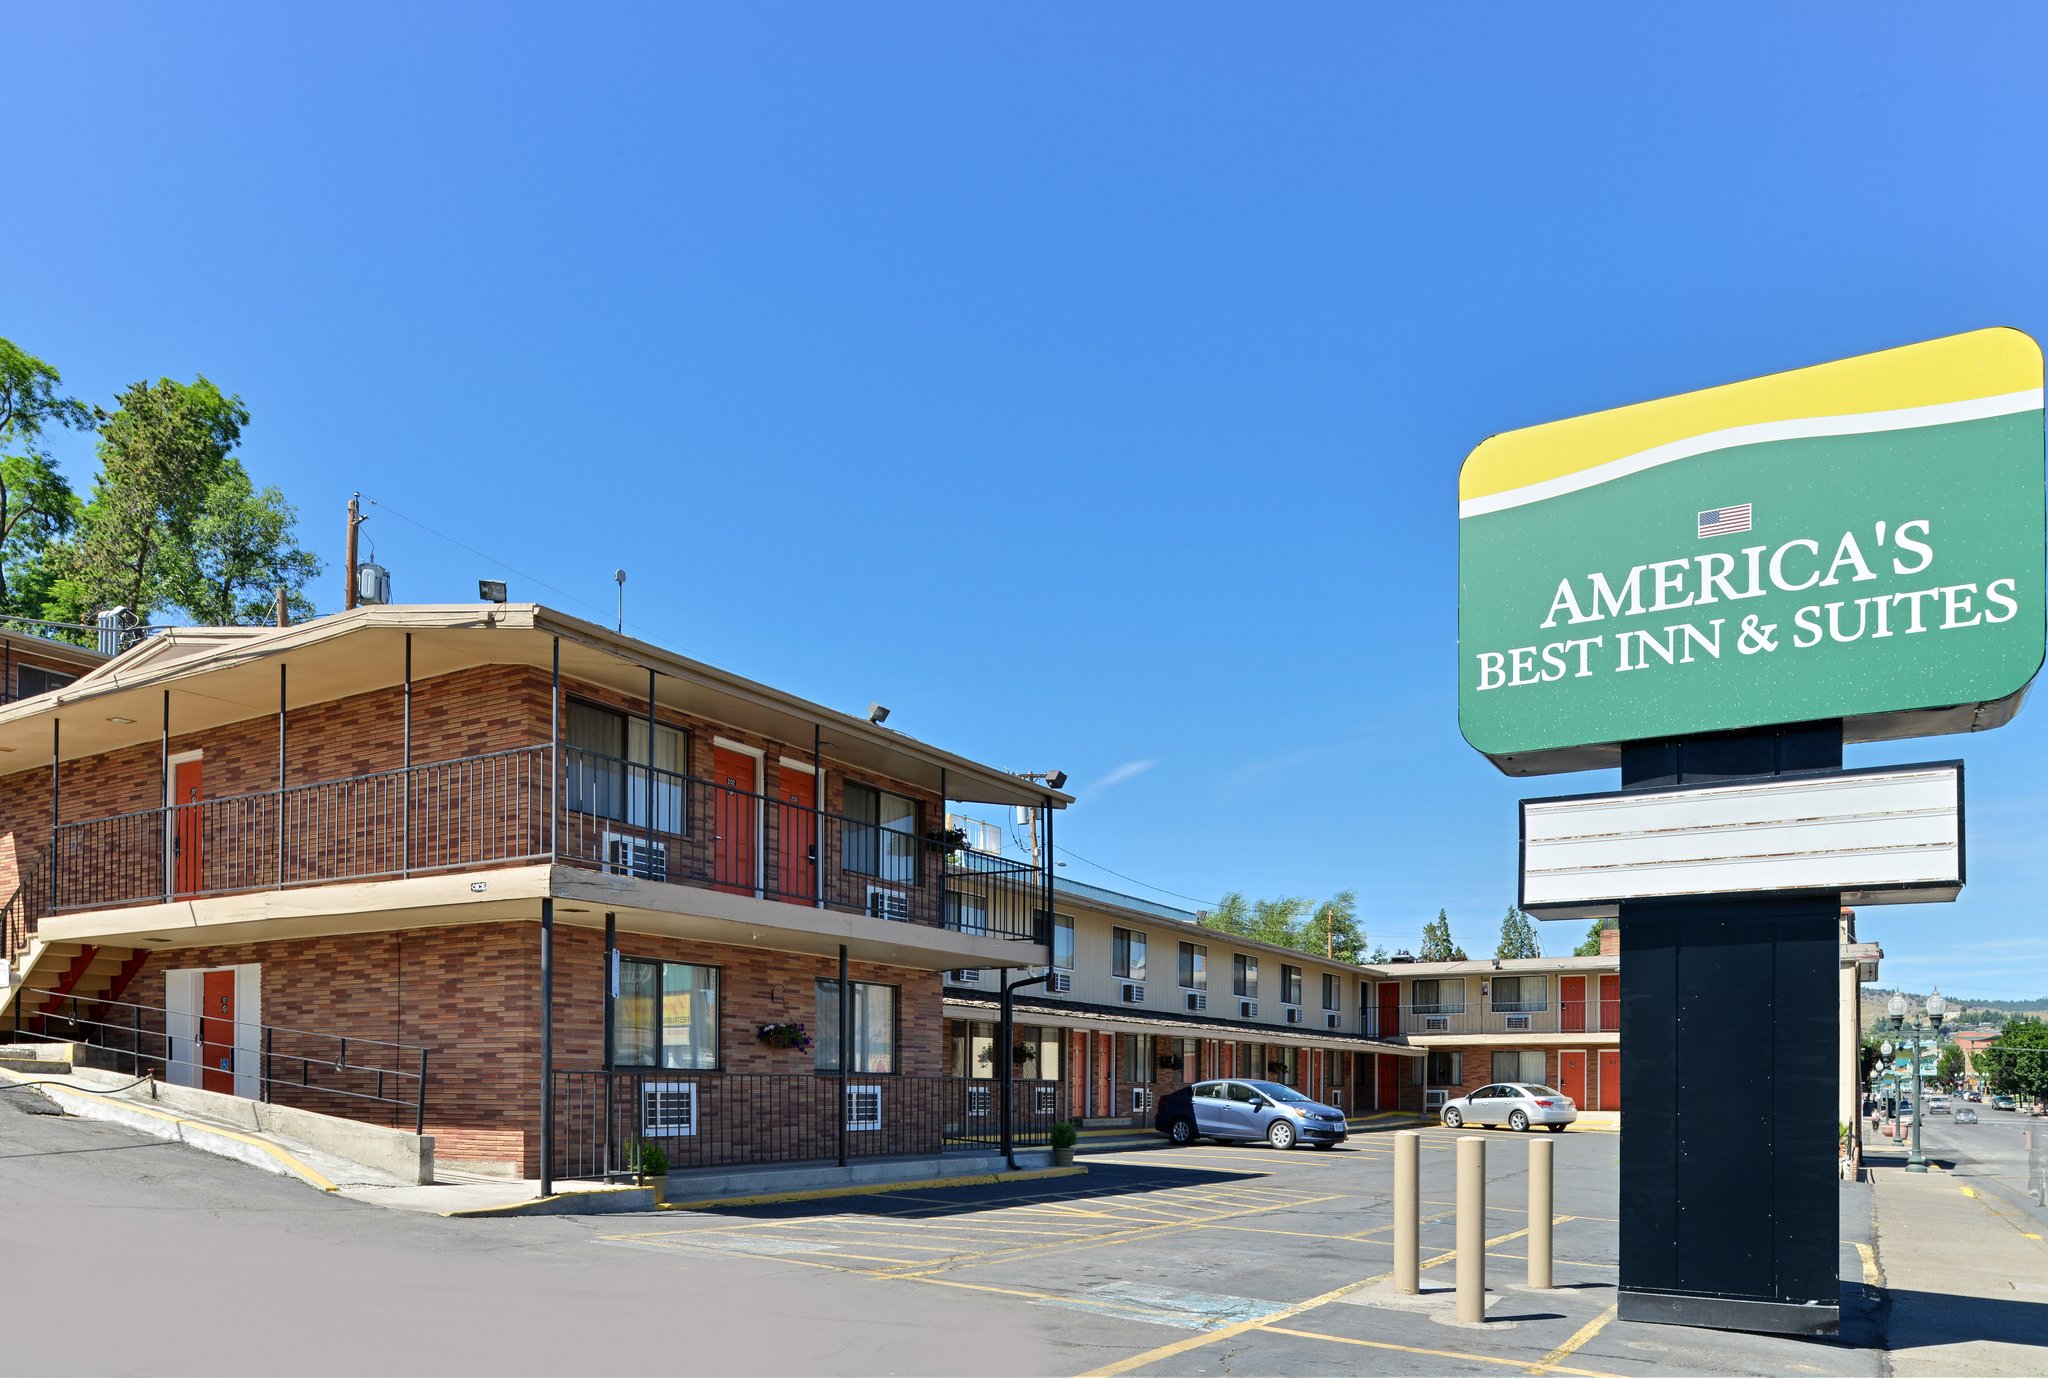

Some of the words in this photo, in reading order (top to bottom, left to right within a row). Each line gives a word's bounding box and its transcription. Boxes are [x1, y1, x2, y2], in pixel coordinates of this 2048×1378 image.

[1540, 519, 1933, 629] AMERICA'S
[1476, 635, 1603, 691] BEST
[1615, 618, 1726, 672] INN
[1737, 613, 1779, 655] &
[1793, 578, 2018, 648] SUITES
